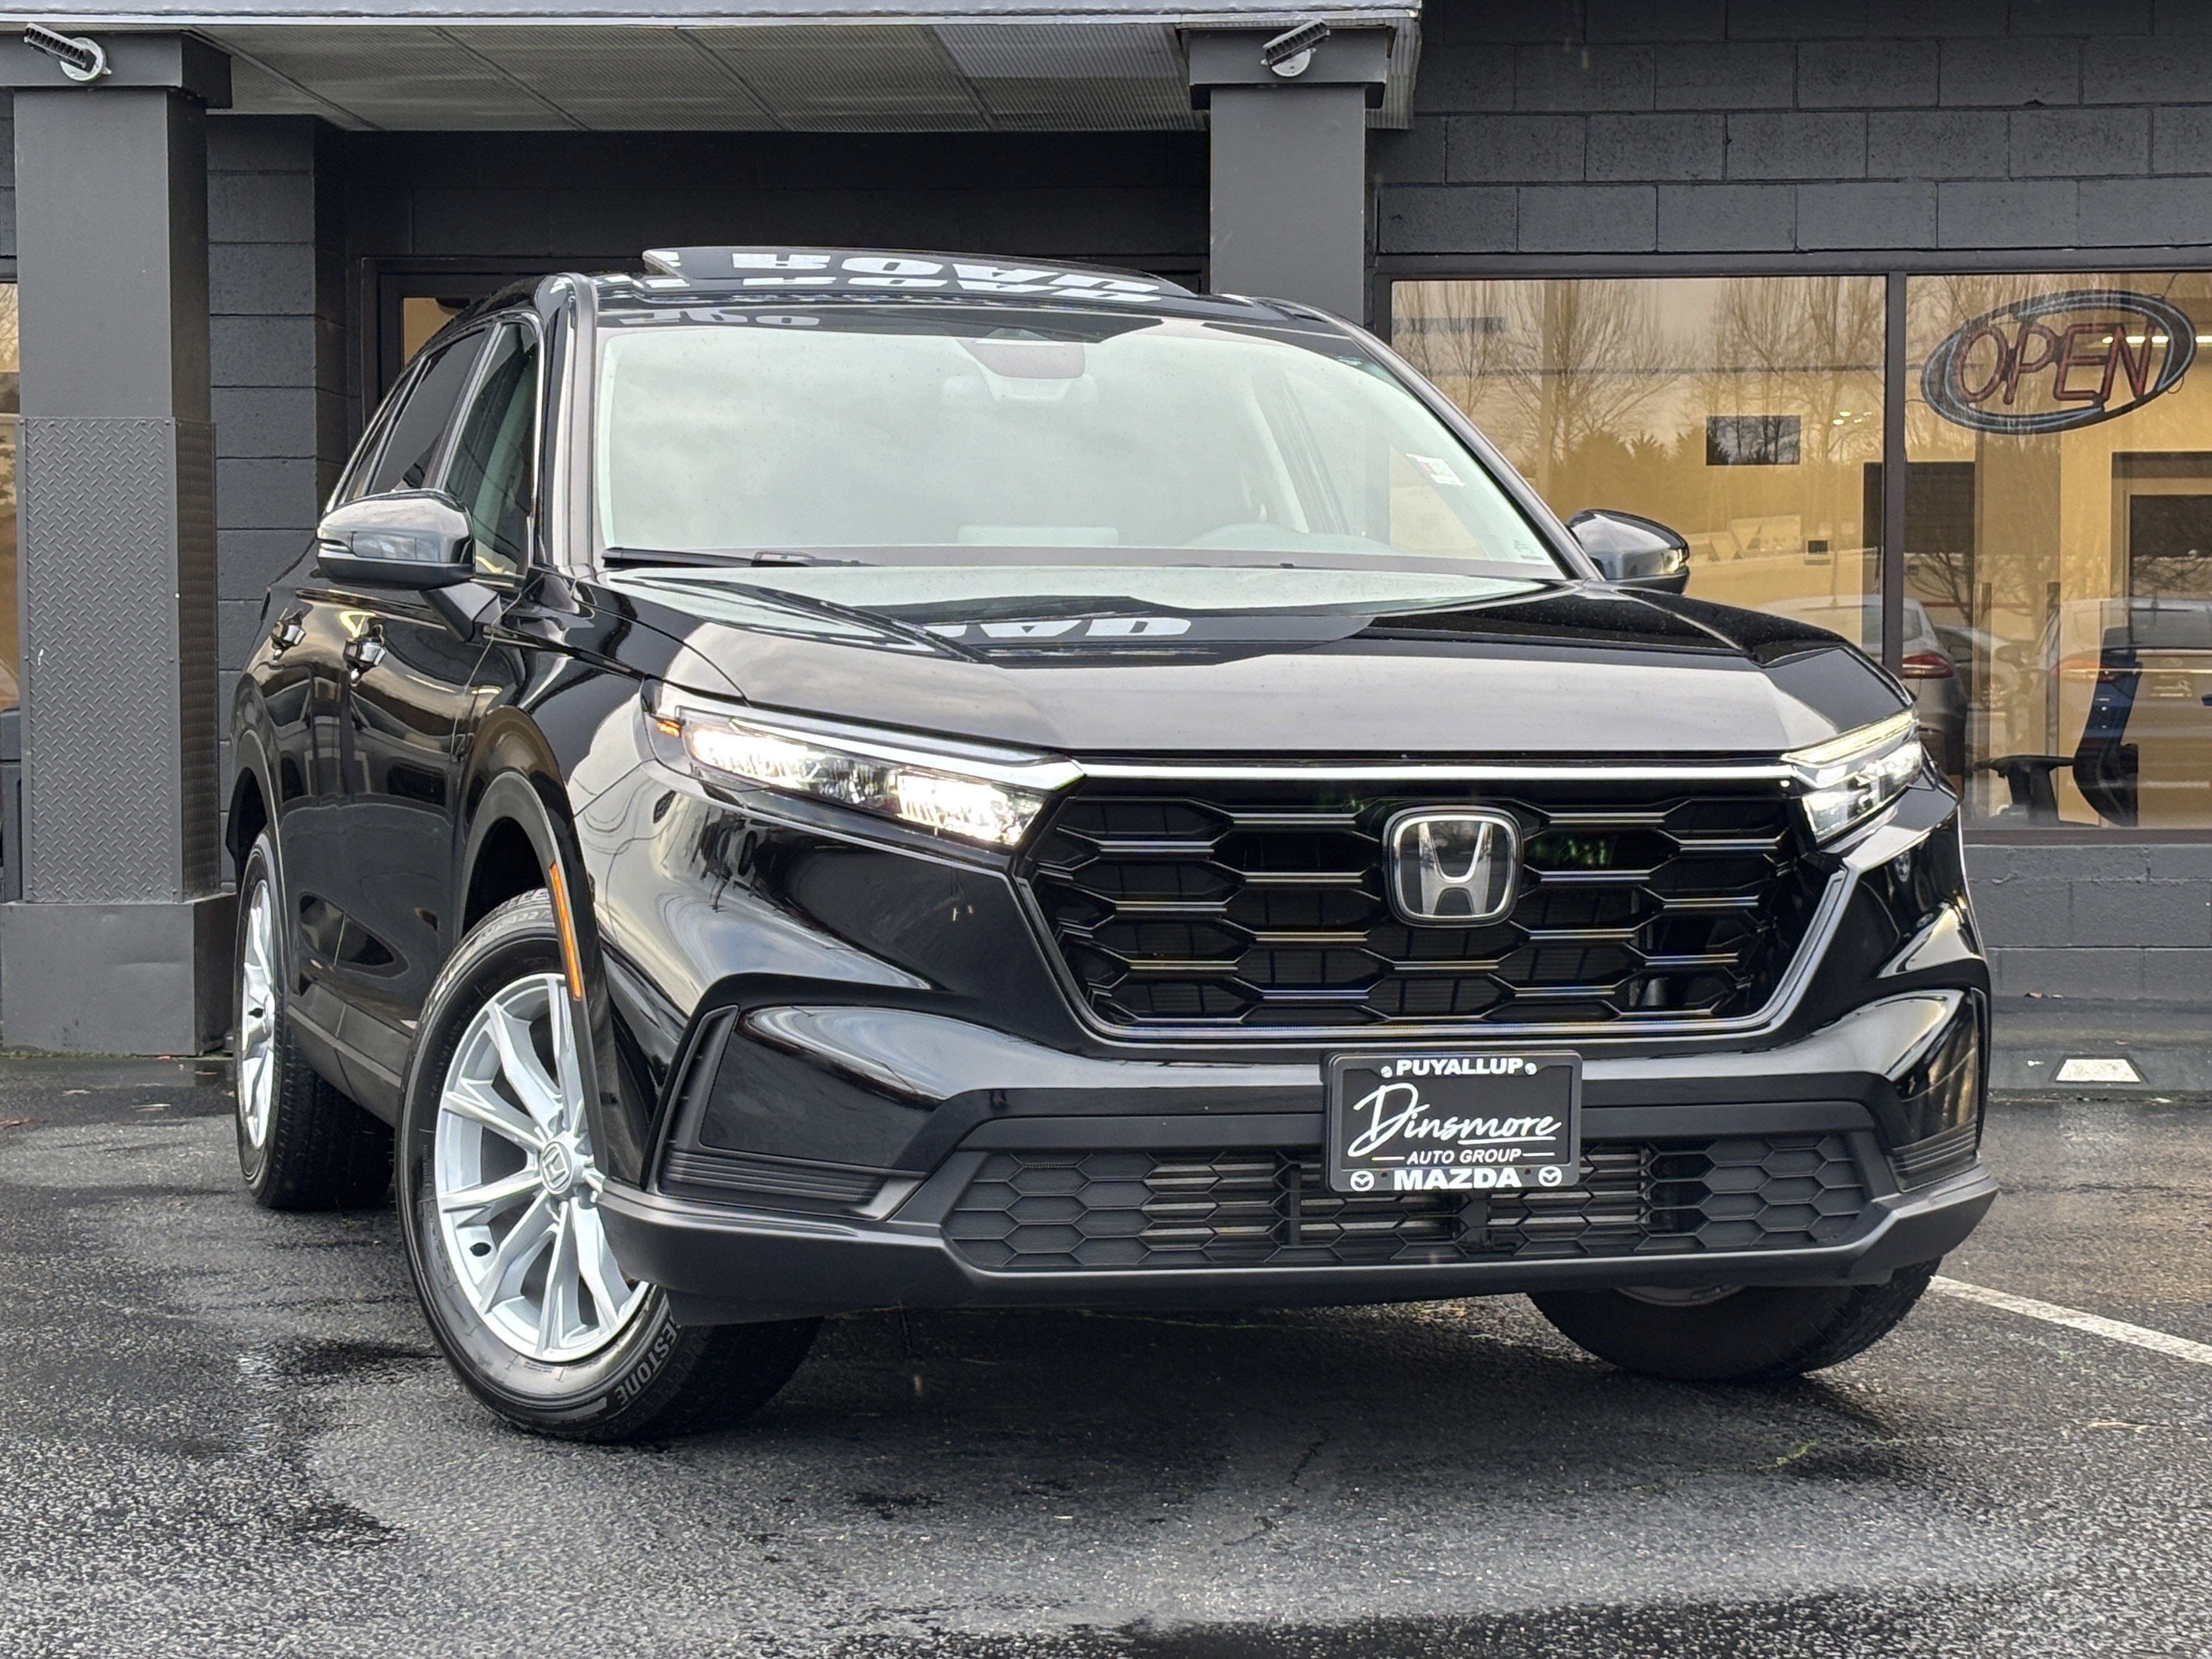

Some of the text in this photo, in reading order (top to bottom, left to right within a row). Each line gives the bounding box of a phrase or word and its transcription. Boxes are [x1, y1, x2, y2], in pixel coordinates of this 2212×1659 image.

[1956, 323, 2155, 405] OPEN
[1396, 1058, 1523, 1076] PUYALLUP
[1347, 1082, 1562, 1157] Dinsmore
[1407, 1148, 1522, 1165] AUTO GROUP
[1393, 1167, 1522, 1190] MAZDA
